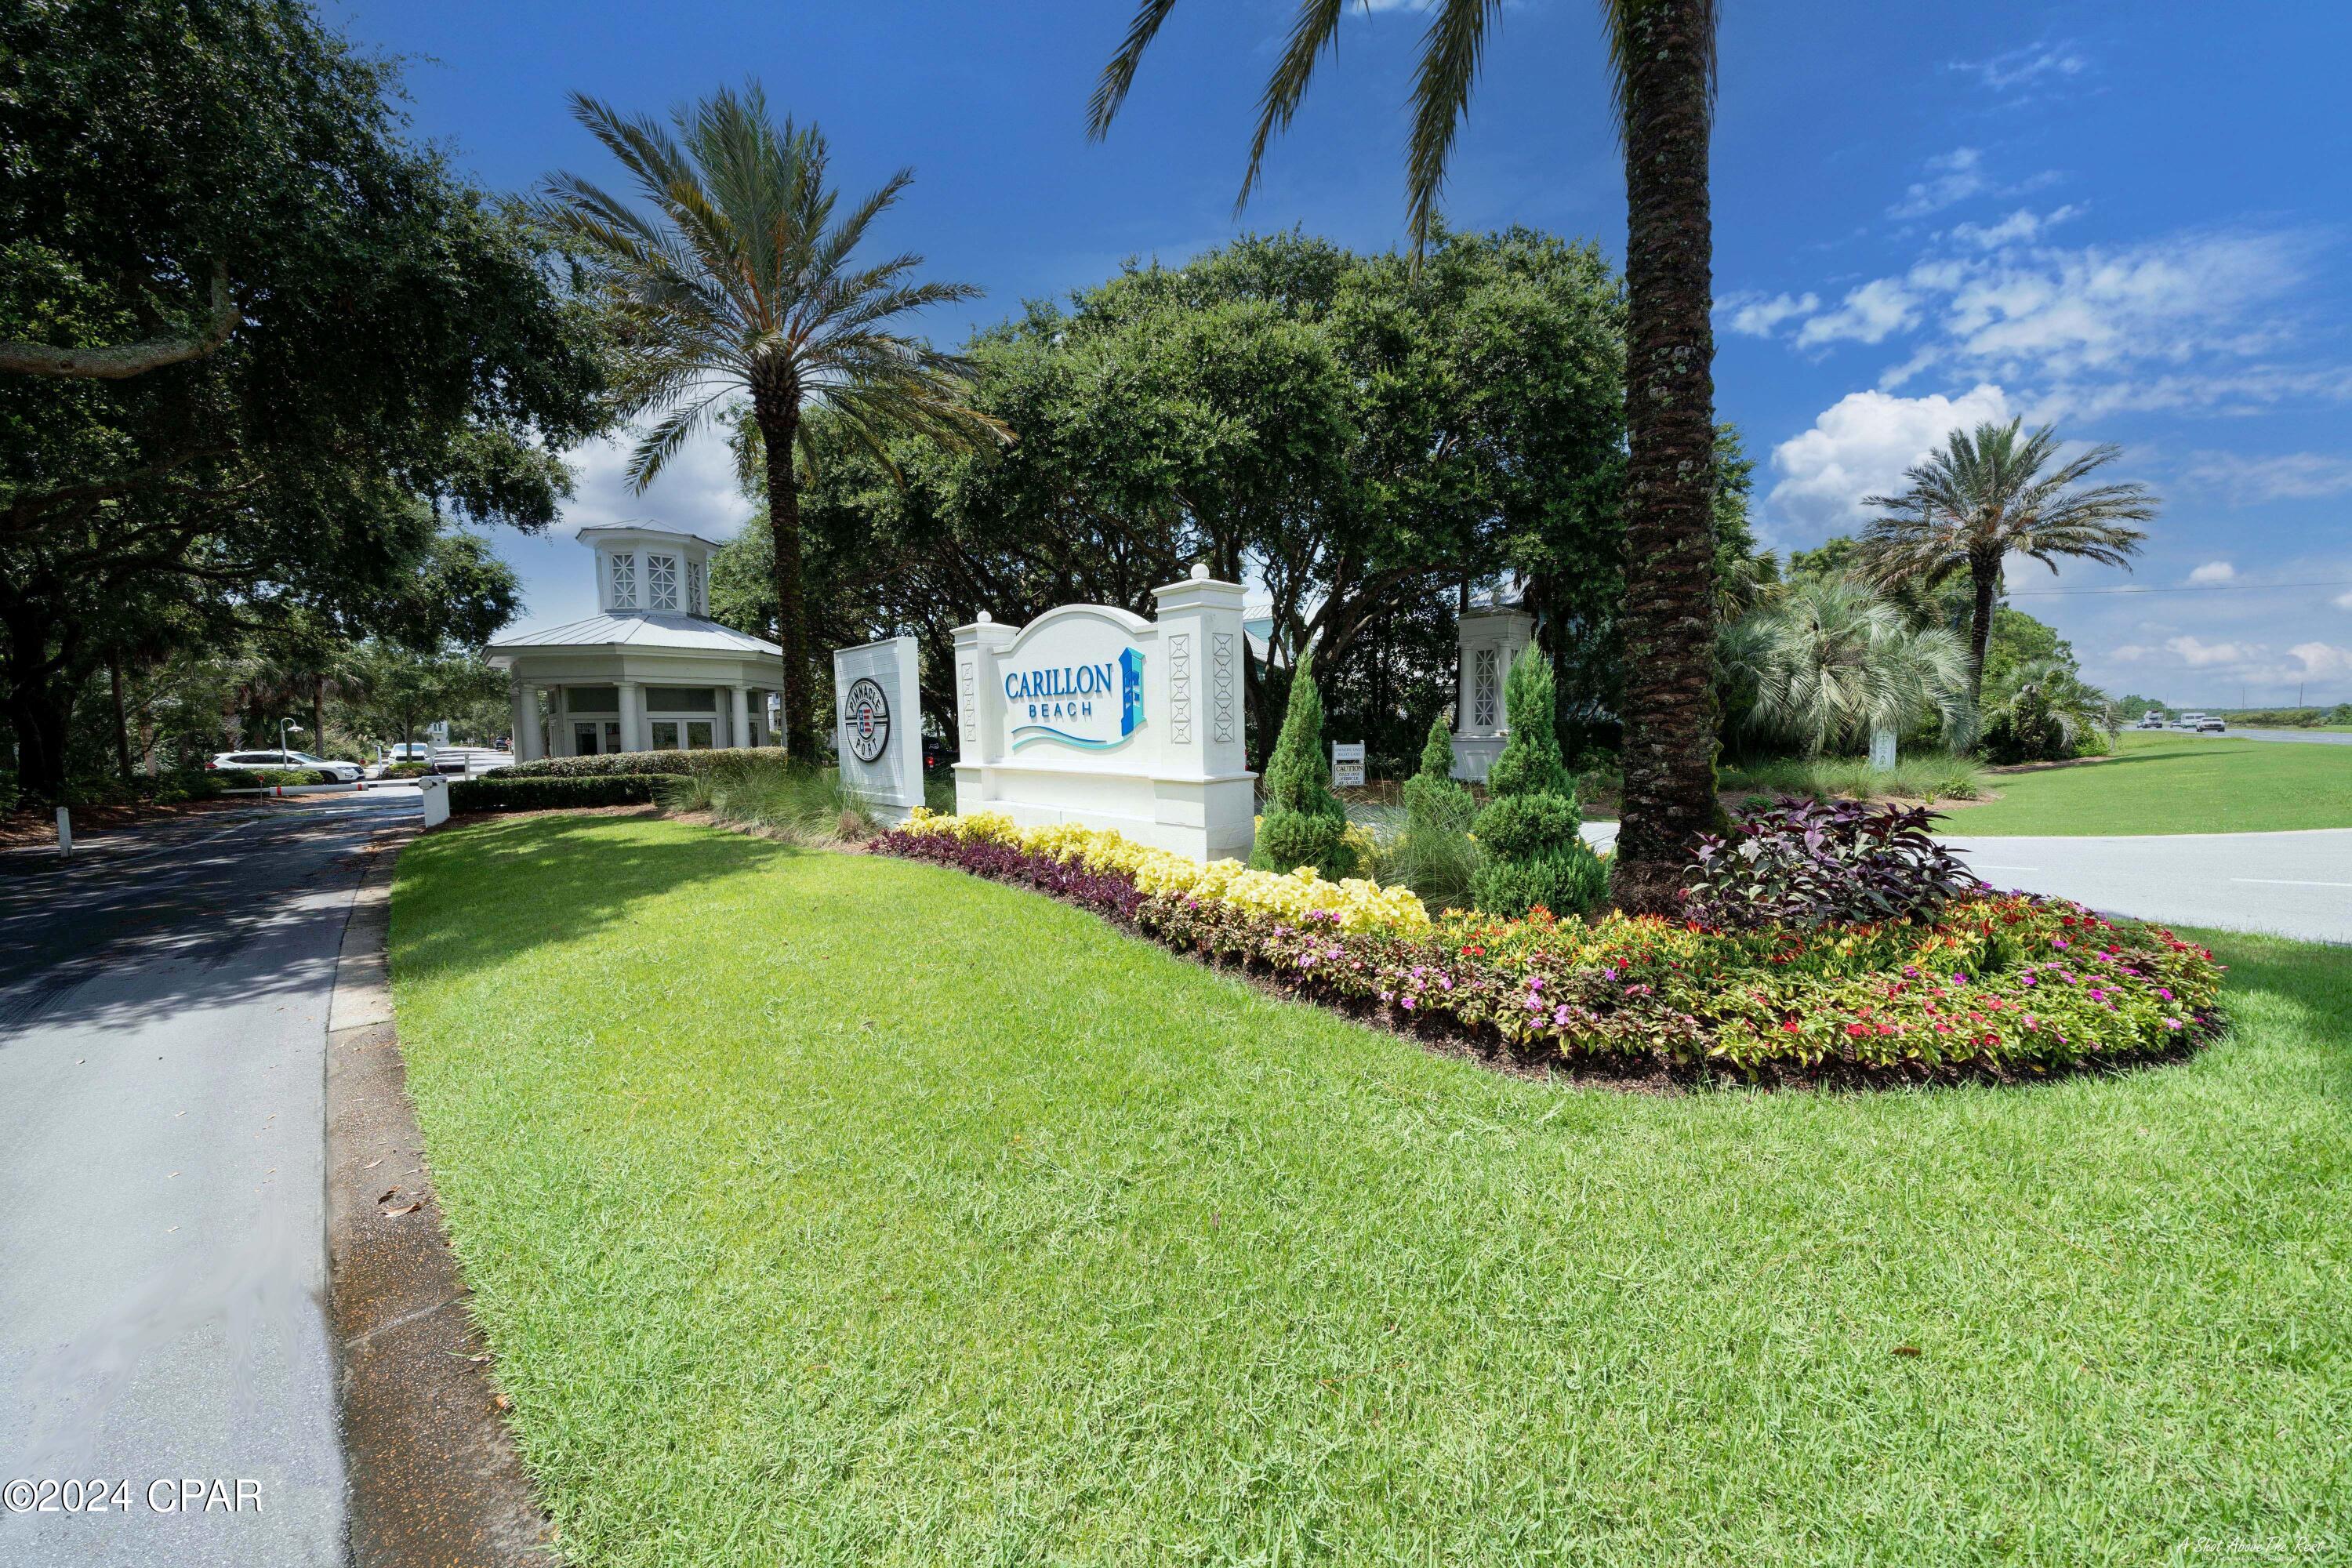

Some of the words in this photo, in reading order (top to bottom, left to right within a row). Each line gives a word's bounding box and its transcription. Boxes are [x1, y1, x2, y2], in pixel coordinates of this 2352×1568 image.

[1005, 663, 1112, 699] CARILLON
[849, 684, 881, 713] PINNACLE
[1029, 701, 1091, 718] BEACH
[855, 737, 877, 757] PORT
